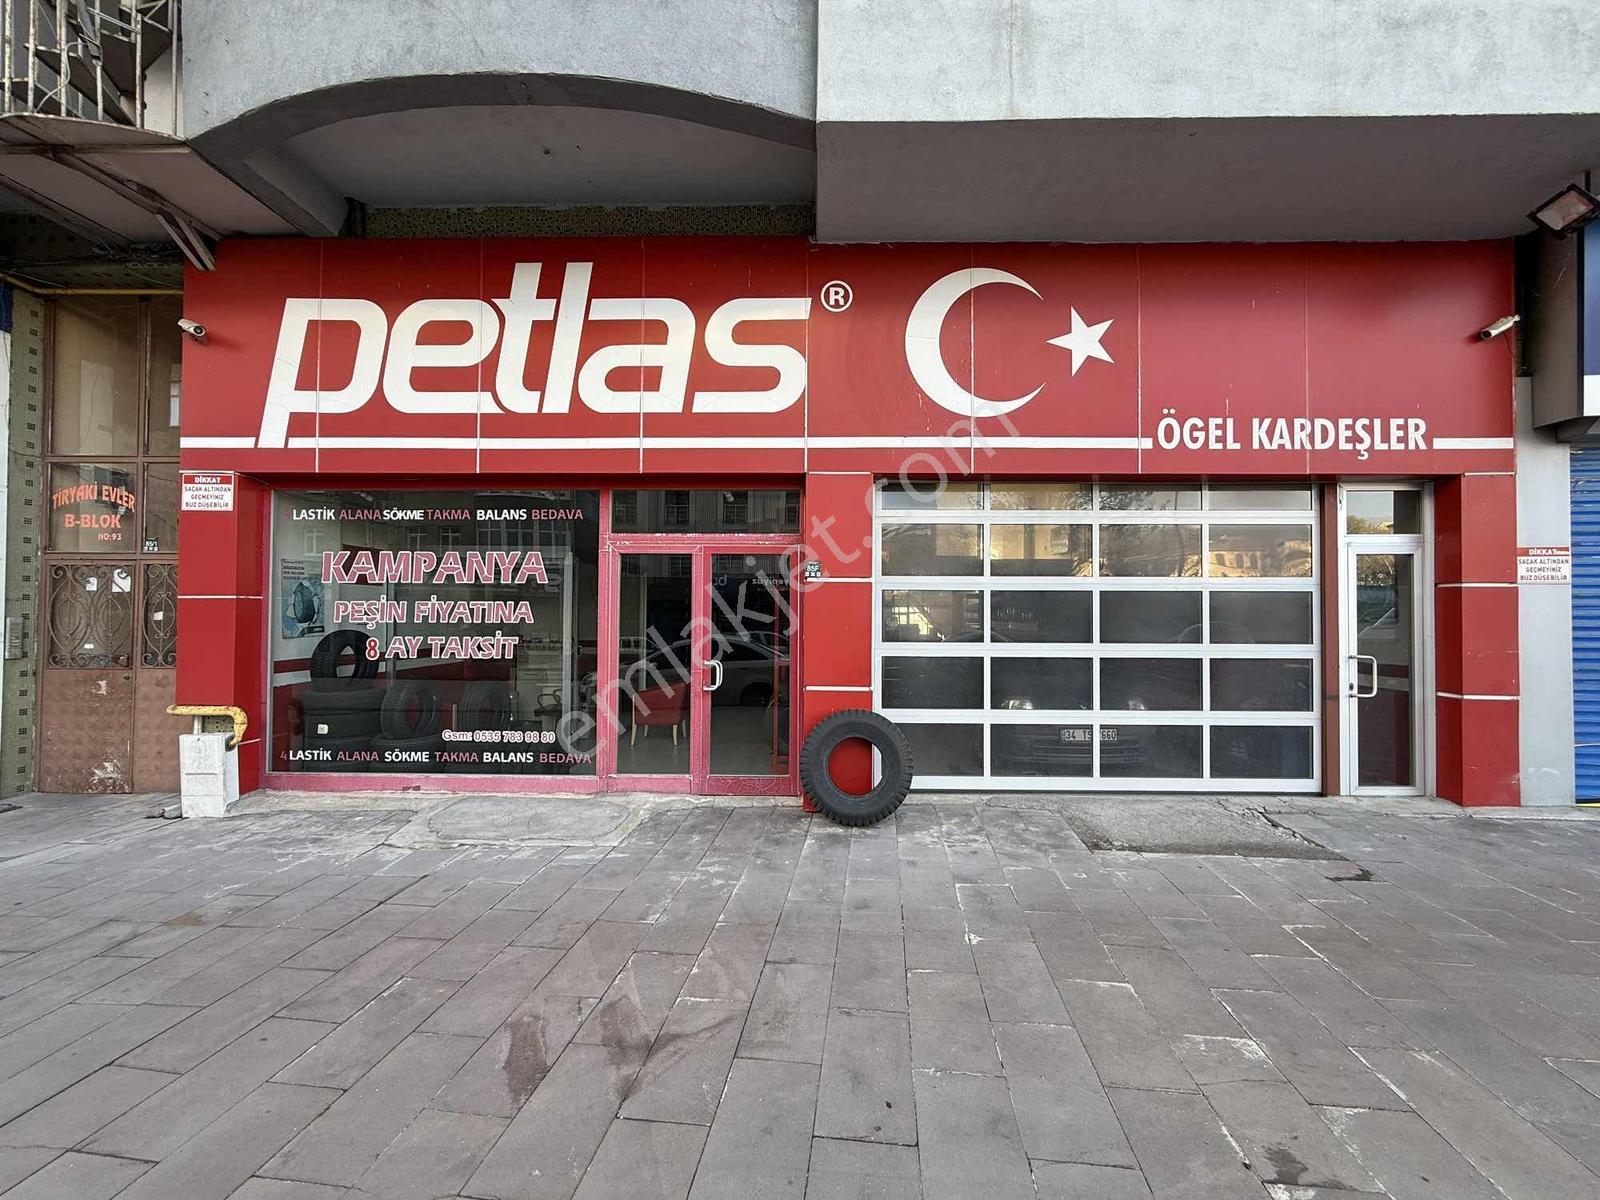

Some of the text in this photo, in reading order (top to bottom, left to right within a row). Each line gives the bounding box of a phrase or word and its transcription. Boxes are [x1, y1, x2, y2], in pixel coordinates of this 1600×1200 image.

[257, 261, 812, 449] petlas
[1157, 408, 1428, 461] ÖGEL KARDEŞLER
[194, 475, 222, 484] DİKKAT
[102, 485, 136, 513] EVLER
[64, 513, 121, 528] B-BLOK
[292, 506, 335, 521] LASTİK
[338, 509, 382, 521] ALANA
[382, 507, 424, 521] SÖKME
[426, 509, 471, 521] TAKMA
[476, 509, 527, 521] BALANS
[531, 509, 584, 520] BEDAVA
[97, 533, 122, 541] NO:93
[1528, 548, 1558, 556] DİKKAT
[321, 551, 549, 584] KAMPANYA
[333, 595, 534, 630] PEŞİN FİYATINA
[365, 631, 519, 660] 8 AY TAKSİT
[442, 729, 556, 744] Gsm: 0535 783 98 80
[1064, 730, 1076, 740] 34
[289, 748, 332, 761] LASTİK
[336, 751, 379, 762] ALANA
[384, 749, 430, 763] SÖKME
[434, 751, 479, 763] TAKMA
[483, 752, 534, 763] BALANS
[539, 752, 592, 764] BEDAVA
